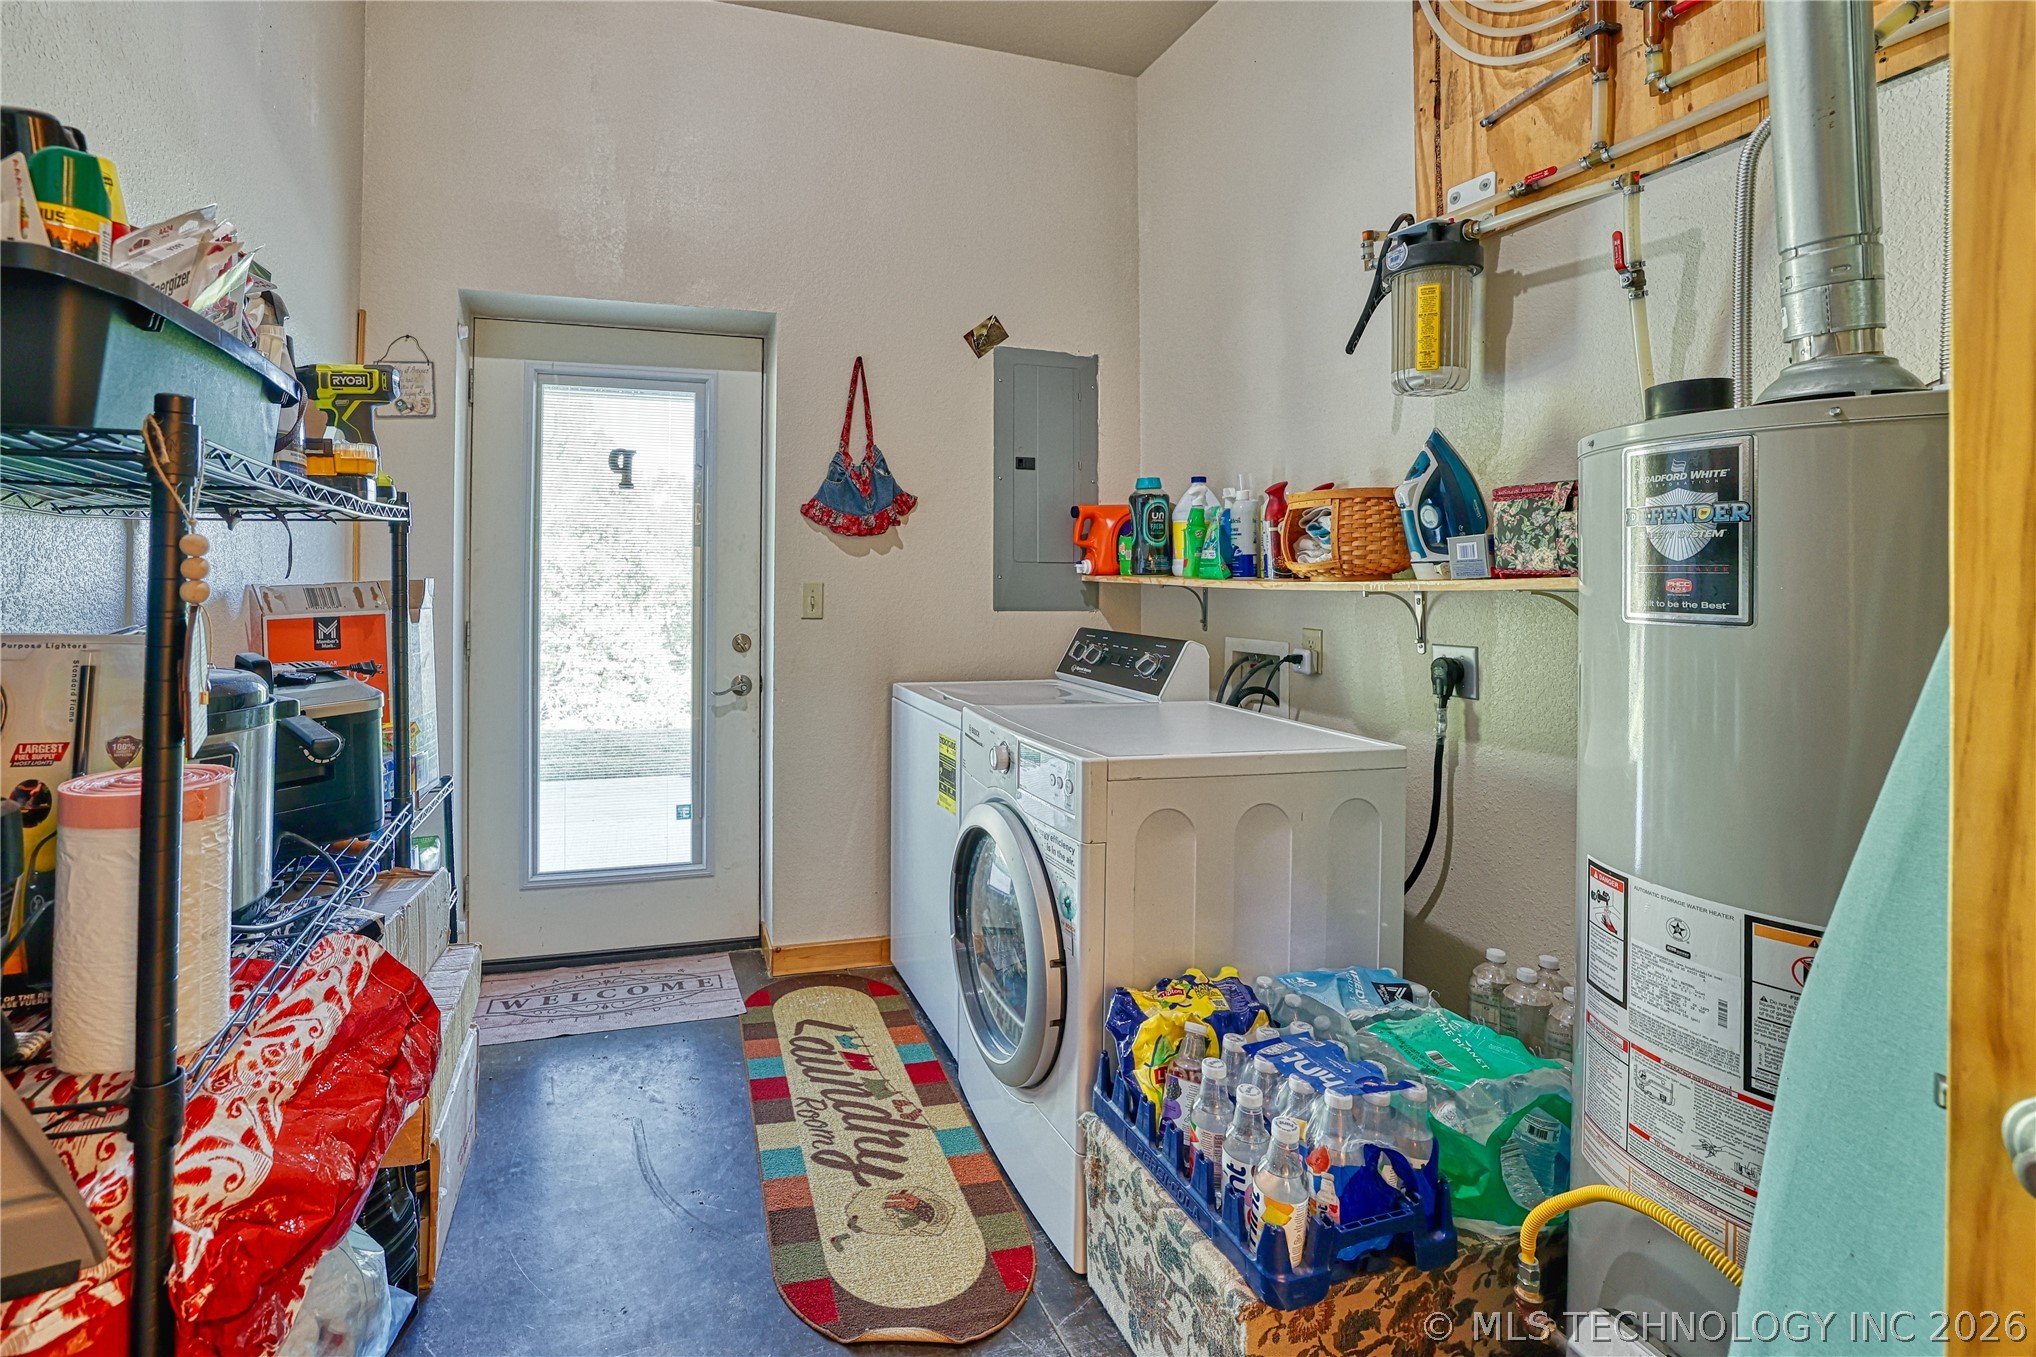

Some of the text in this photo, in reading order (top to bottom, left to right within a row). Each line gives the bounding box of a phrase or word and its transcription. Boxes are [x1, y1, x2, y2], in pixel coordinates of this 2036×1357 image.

[331, 376, 366, 386] RYOBI
[1638, 468, 1728, 484] BRADFORD WHITE
[1644, 479, 1719, 489] ORPORATION
[1667, 600, 1679, 608] be
[1682, 601, 1698, 609] the
[1701, 601, 1727, 610] Best
[1, 642, 87, 651] Purpose Lighters
[68, 660, 80, 723] Standard Flame
[19, 743, 64, 754] LARGEST
[112, 743, 136, 751] 100%
[31, 753, 57, 761] SUPPLY
[1599, 875, 1619, 889] DANGER
[1633, 885, 1735, 921] AUTOMATIC STORAGE WATER HEATER
[500, 978, 714, 1011] WELCOME
[1434, 1017, 1456, 1038] THE
[1452, 1037, 1490, 1070] PLANET
[1281, 1051, 1345, 1088] hint
[789, 1019, 929, 1188] Laundry
[795, 1096, 836, 1150] Room
